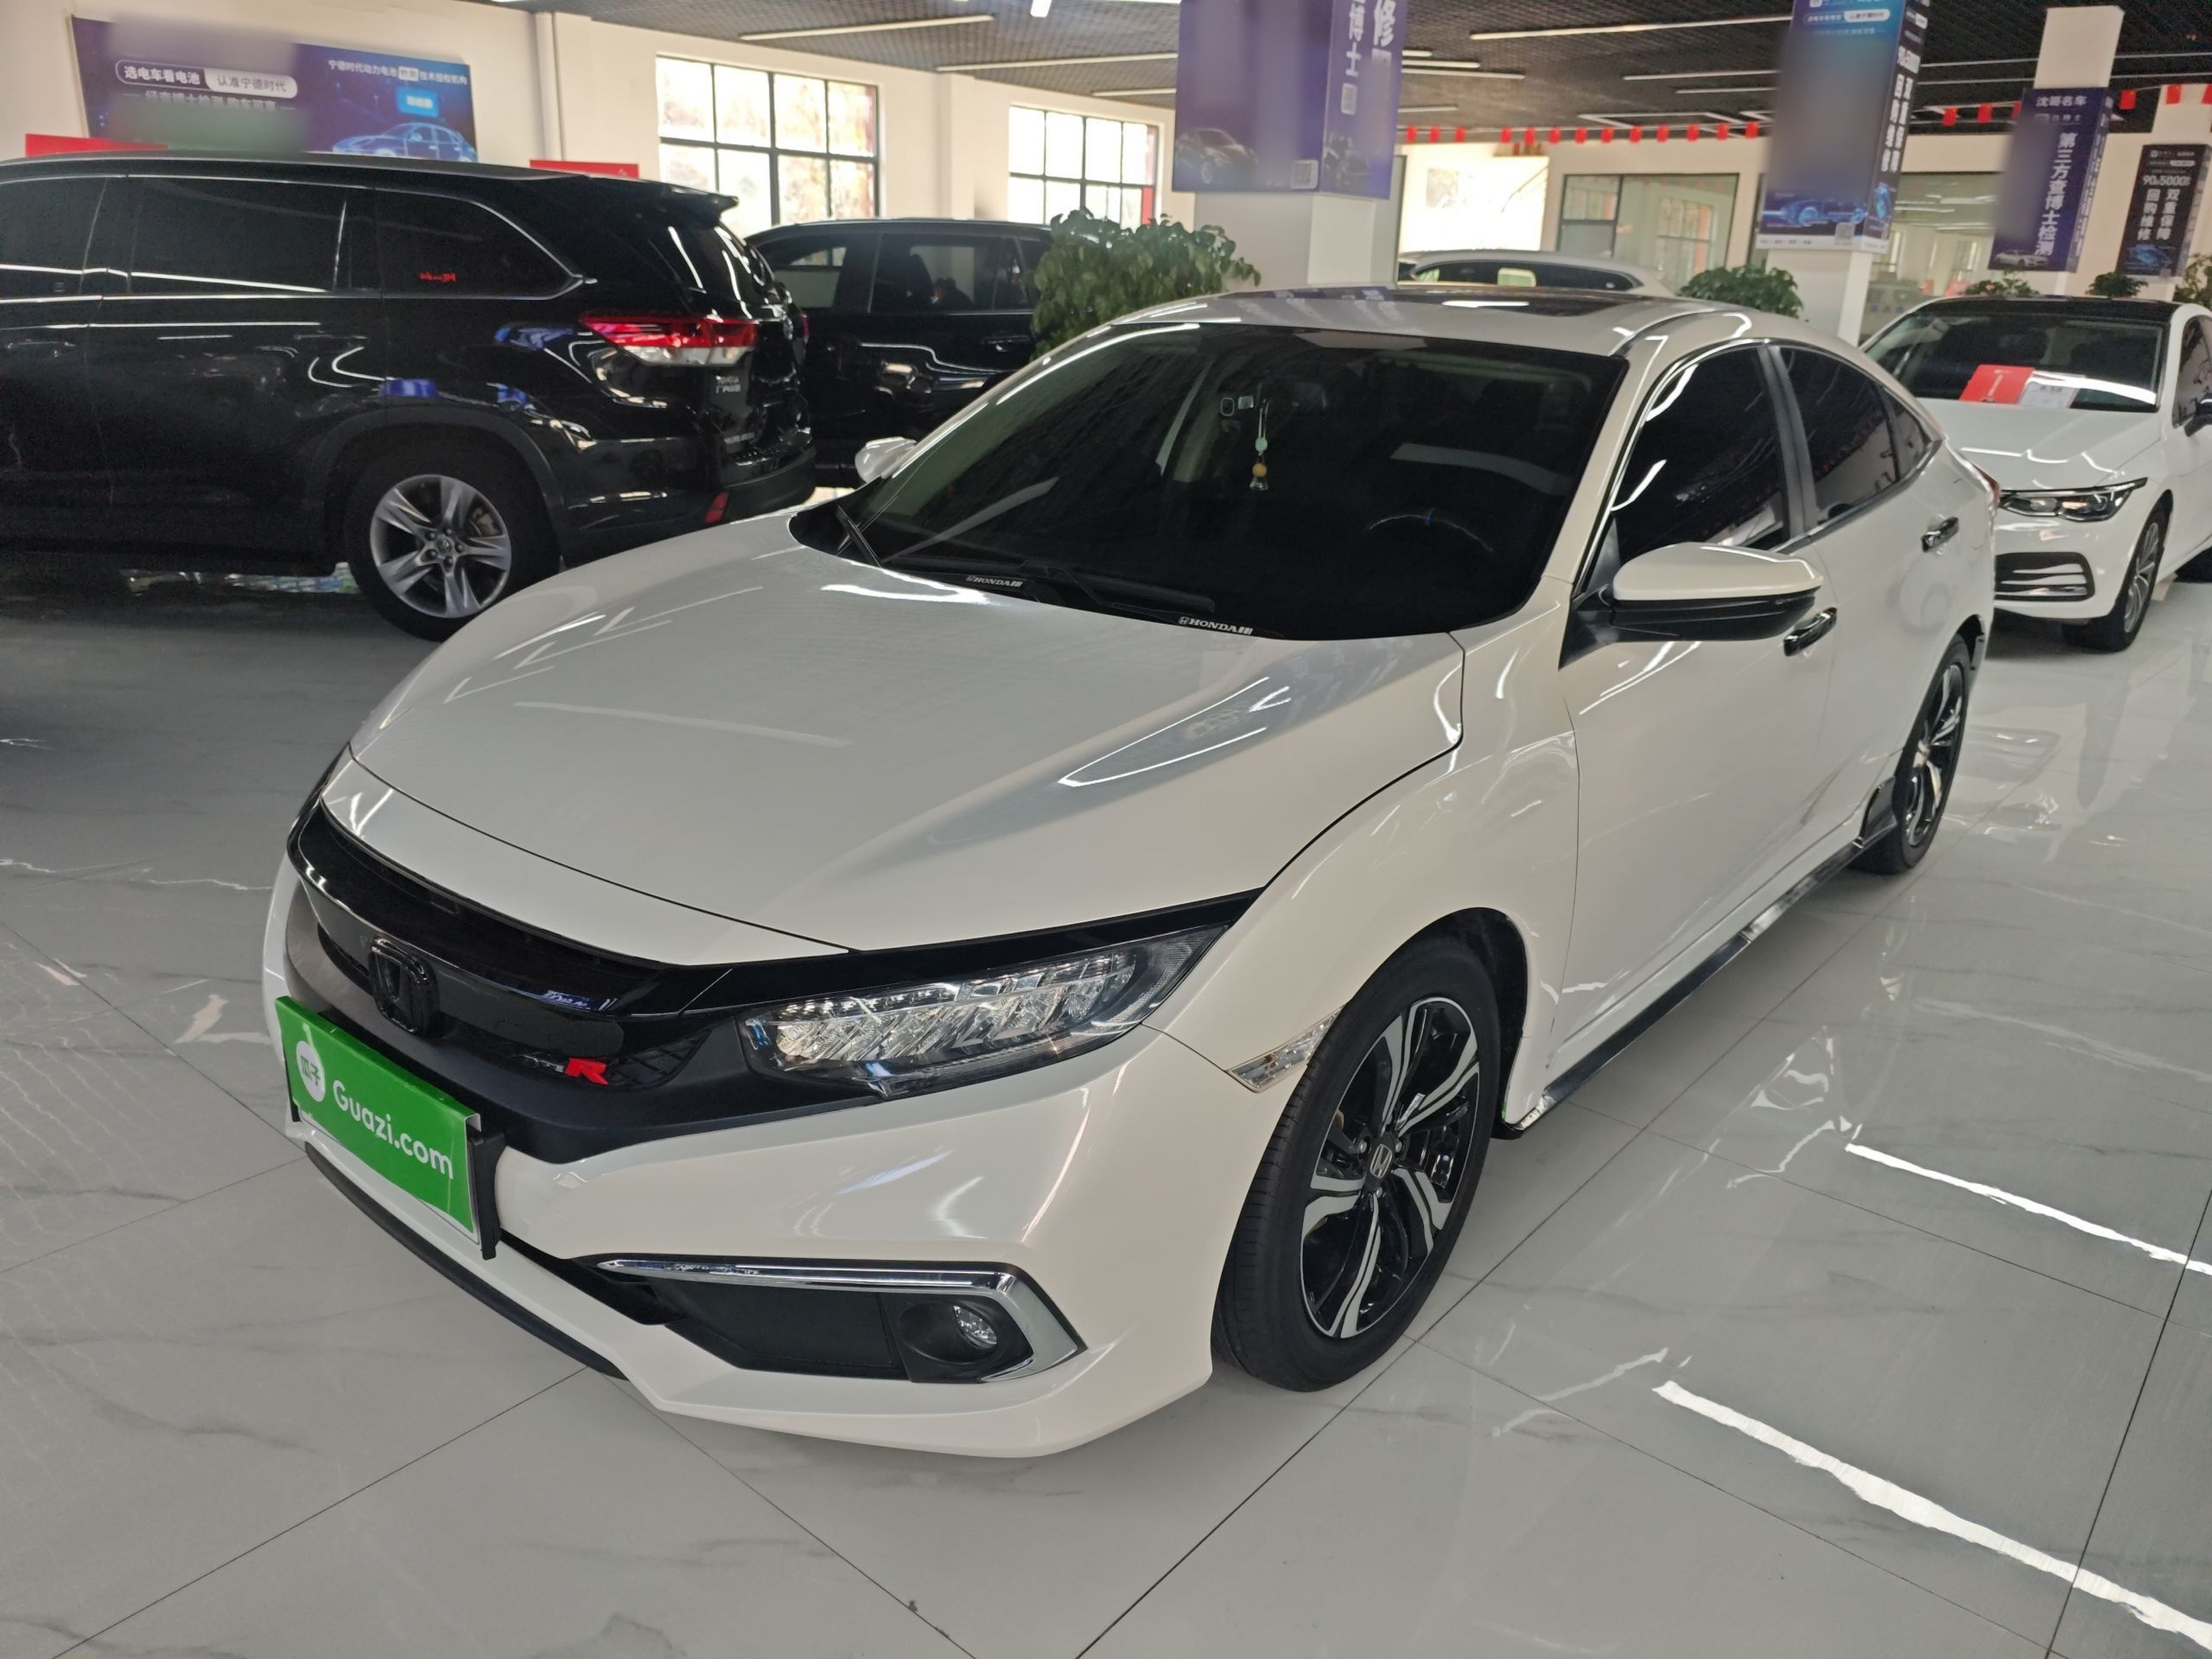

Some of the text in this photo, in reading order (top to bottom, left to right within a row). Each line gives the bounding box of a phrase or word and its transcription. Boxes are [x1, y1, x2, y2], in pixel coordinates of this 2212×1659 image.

[124, 66, 200, 85] 选电车看电池
[217, 75, 287, 92] 认准宁德时代
[2034, 132, 2078, 256] 第三方查博士检测
[973, 577, 1010, 586] HONDA
[1189, 619, 1238, 632] HONDA
[300, 1055, 320, 1086] 瓜子
[565, 1058, 609, 1086] R
[333, 1080, 454, 1180] Guazi.com
